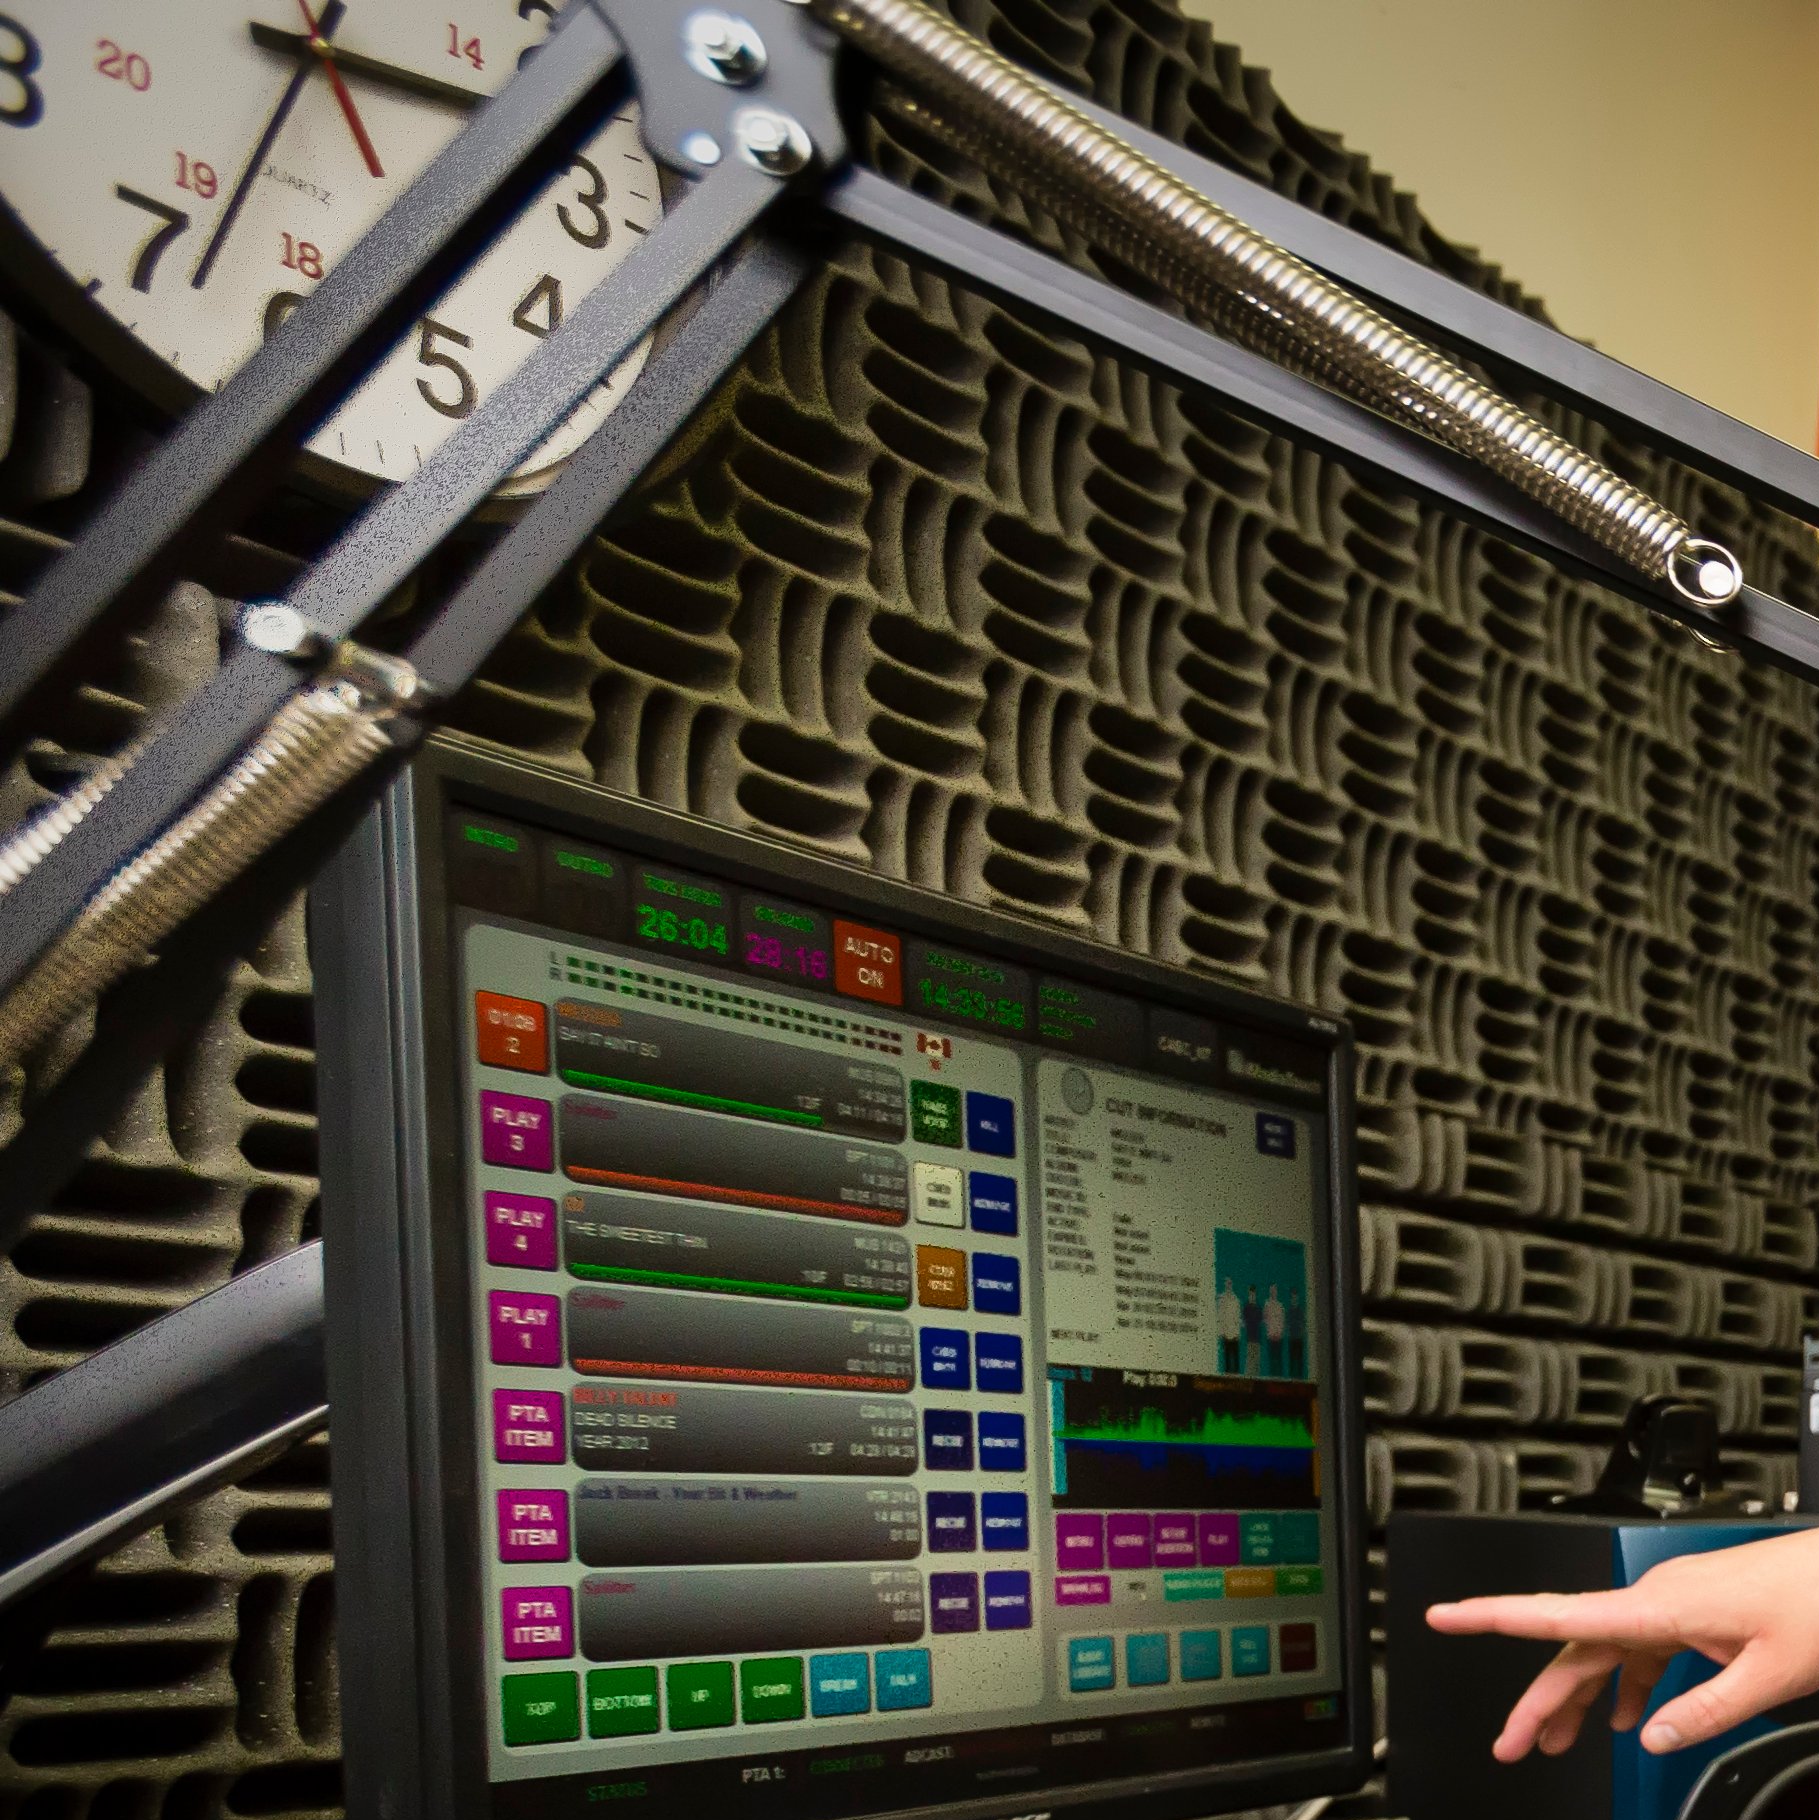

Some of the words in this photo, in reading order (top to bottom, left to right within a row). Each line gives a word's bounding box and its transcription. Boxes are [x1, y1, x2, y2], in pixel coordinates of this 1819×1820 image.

[447, 23, 485, 70] 14
[95, 38, 152, 92] 20
[174, 151, 219, 199] 19
[556, 155, 611, 249] 3
[116, 183, 189, 292] 7
[281, 232, 324, 280] 18
[416, 316, 480, 420] 5
[636, 903, 730, 955] 26:04
[843, 936, 895, 964] AUTO
[857, 967, 886, 990] ON
[491, 1106, 542, 1130] PLAY
[509, 1134, 525, 1153] 3
[493, 1206, 545, 1229] PLAY
[512, 1233, 529, 1252] 4
[498, 1305, 550, 1328] PLAY
[518, 1331, 534, 1351] 1
[508, 1404, 549, 1424] PTA
[616, 1412, 678, 1431] SILENCE
[503, 1428, 556, 1448] ITEM
[511, 1503, 554, 1523] PTA
[507, 1527, 559, 1547] ITEM
[517, 1601, 557, 1620] PTA
[512, 1625, 563, 1645] ITEM
